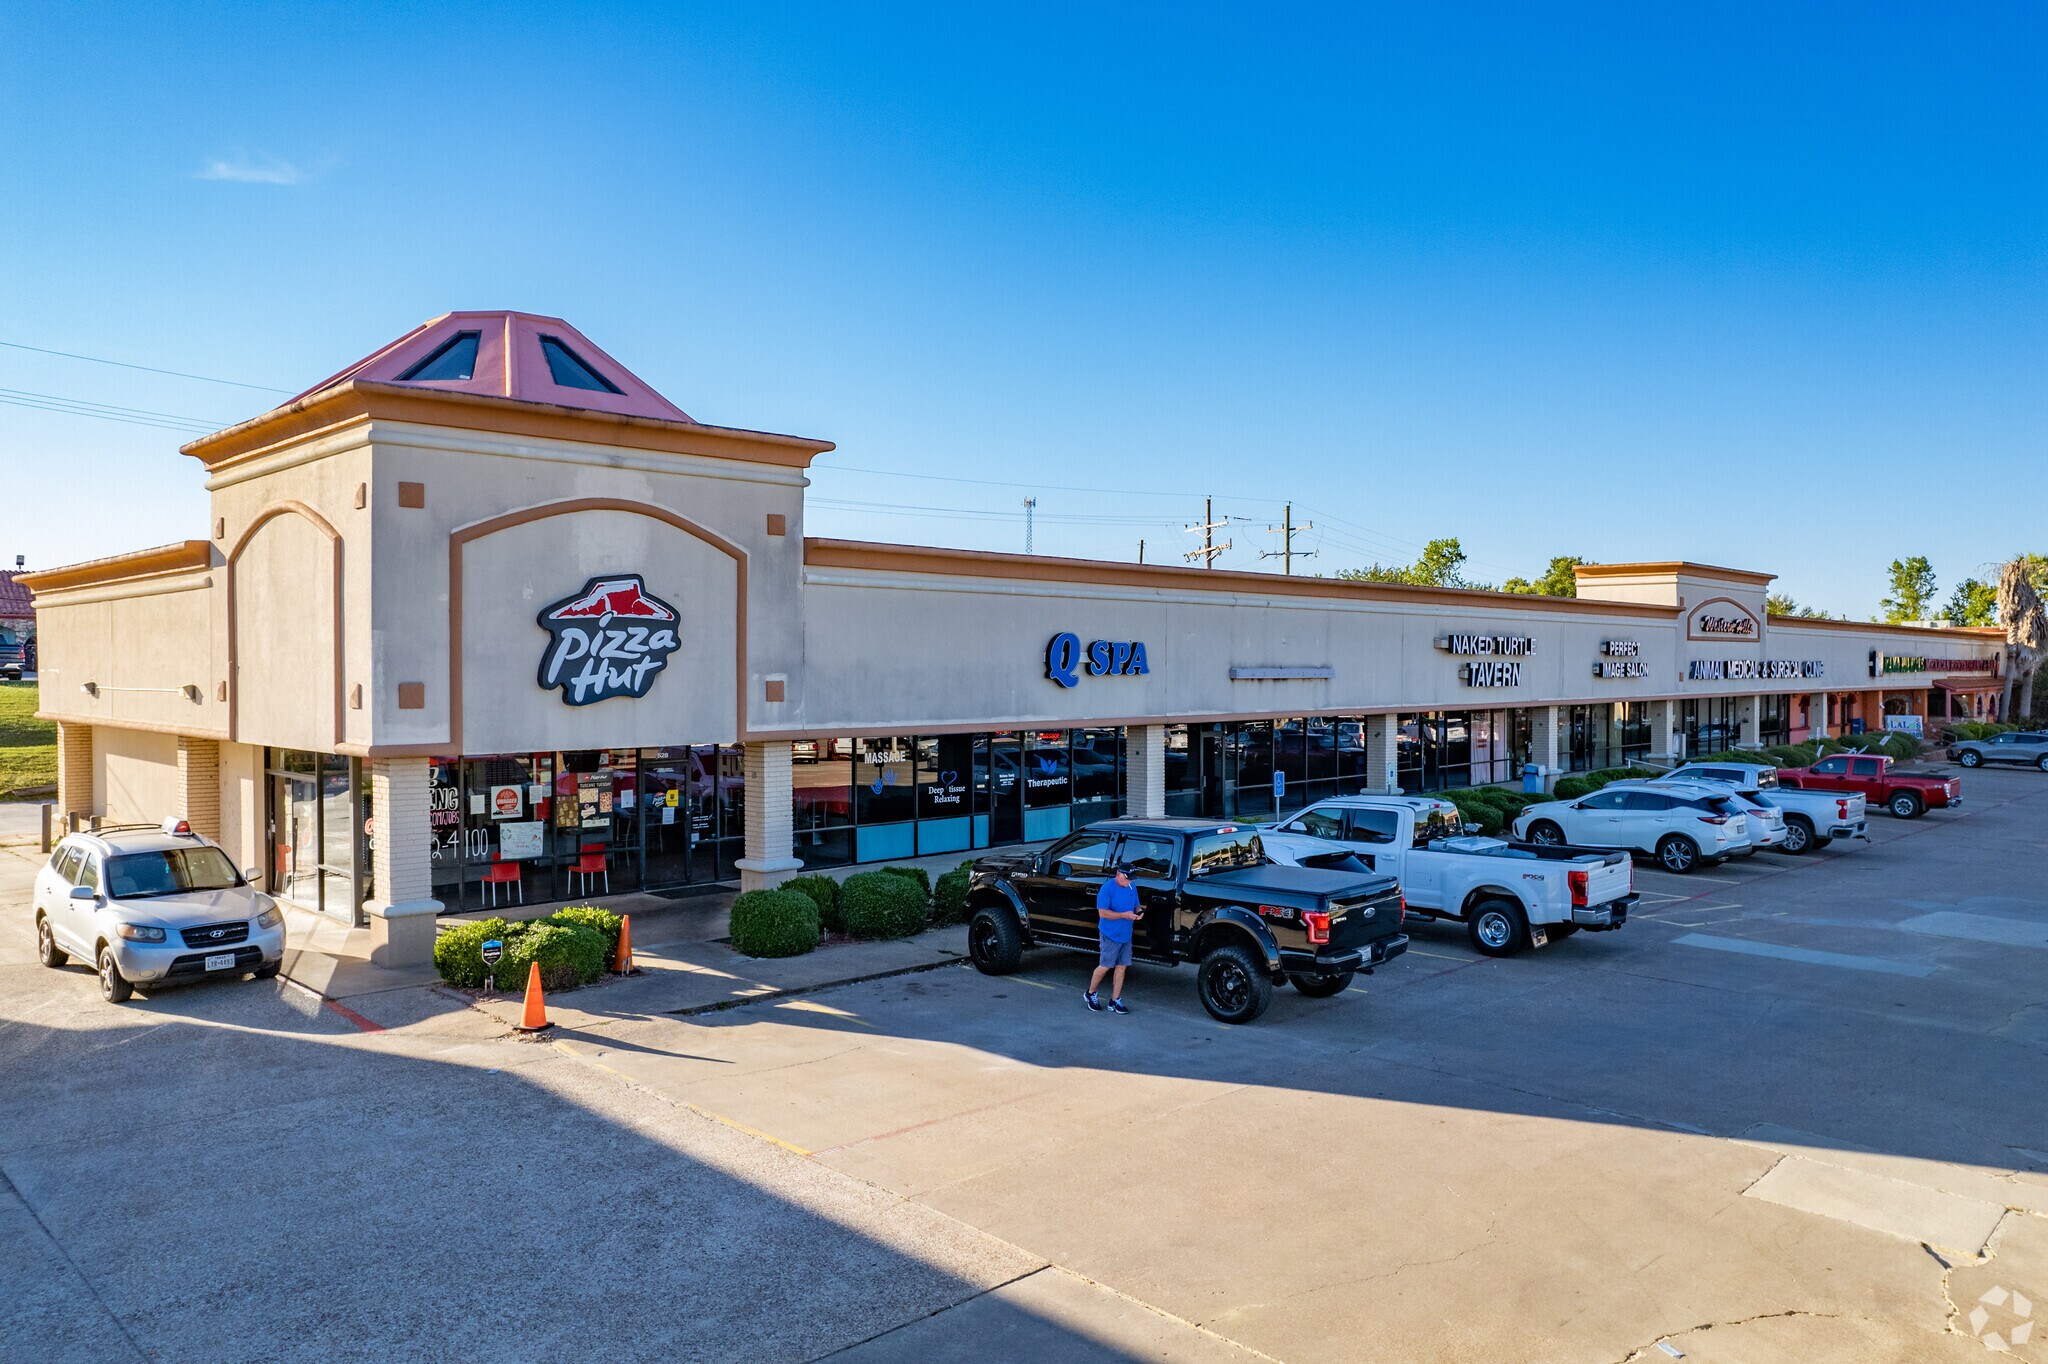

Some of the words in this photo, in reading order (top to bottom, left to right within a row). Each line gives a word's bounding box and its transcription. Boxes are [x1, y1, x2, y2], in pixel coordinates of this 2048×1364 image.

[548, 613, 676, 683] Pizza
[1451, 635, 1493, 654] NAKED
[1496, 636, 1537, 656] TURTLE
[1608, 641, 1641, 656] PERFECT
[1046, 632, 1080, 688] Q
[1088, 640, 1150, 676] SPA
[1468, 662, 1522, 687] TAVERN
[1602, 662, 1625, 678] IMAGE
[1626, 662, 1649, 677] SALON
[1726, 659, 1760, 680] MEDICAL
[1769, 660, 1803, 679] SURGICAL
[571, 655, 662, 703] Hut
[864, 750, 906, 764] MASSAGE
[1027, 776, 1068, 788] Therapeutic
[928, 786, 945, 796] Deep
[948, 785, 965, 793] tissue
[934, 795, 960, 804] Relaxing
[1259, 905, 1294, 919] FX4
